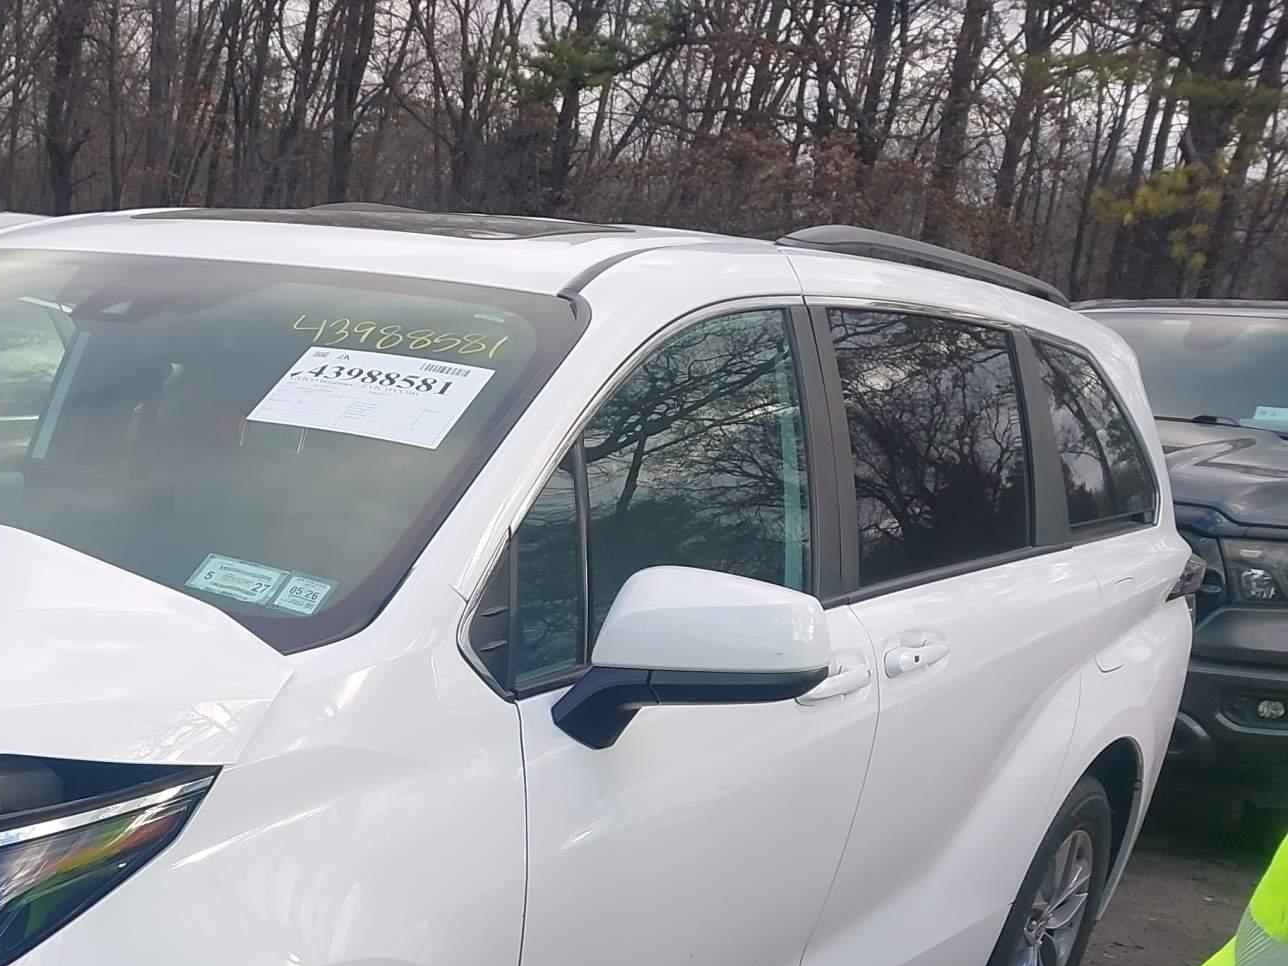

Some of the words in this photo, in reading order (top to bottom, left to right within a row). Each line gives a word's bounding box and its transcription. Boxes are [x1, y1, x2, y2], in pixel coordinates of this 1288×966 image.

[293, 314, 508, 358] 43988581
[307, 363, 453, 396] 43988581
[203, 570, 216, 582] 5
[251, 582, 272, 594] 27
